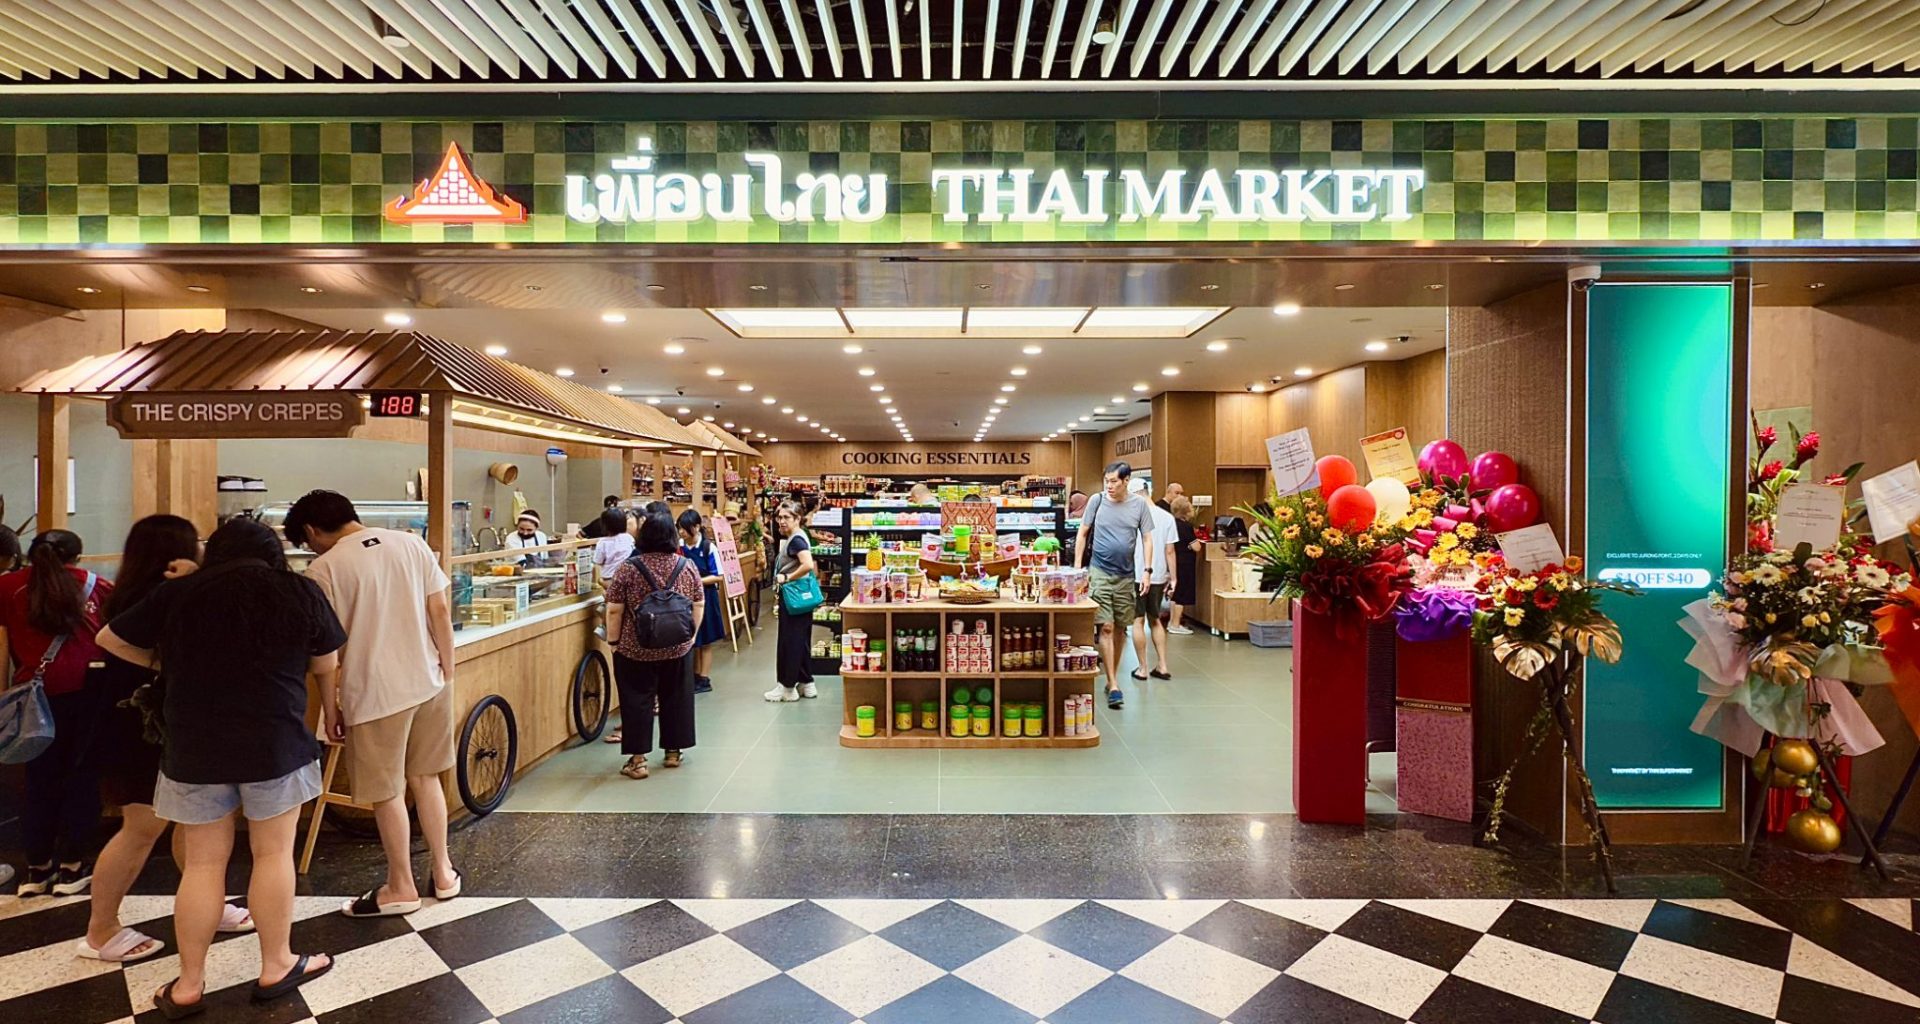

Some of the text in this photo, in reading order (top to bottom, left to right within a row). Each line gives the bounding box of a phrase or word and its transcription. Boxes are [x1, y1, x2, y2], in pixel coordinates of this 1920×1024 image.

[565, 137, 888, 223] เพื่อนไทย
[931, 168, 1425, 223] THAI MARKET
[131, 403, 343, 421] THE CRISPY CREPES
[381, 396, 414, 415] 188
[842, 452, 1031, 465] COOKING ESSENTIALS
[956, 515, 980, 525] BEST
[948, 524, 988, 534] SERS
[1635, 572, 1664, 585] OFF
[1667, 572, 1694, 585] $40
